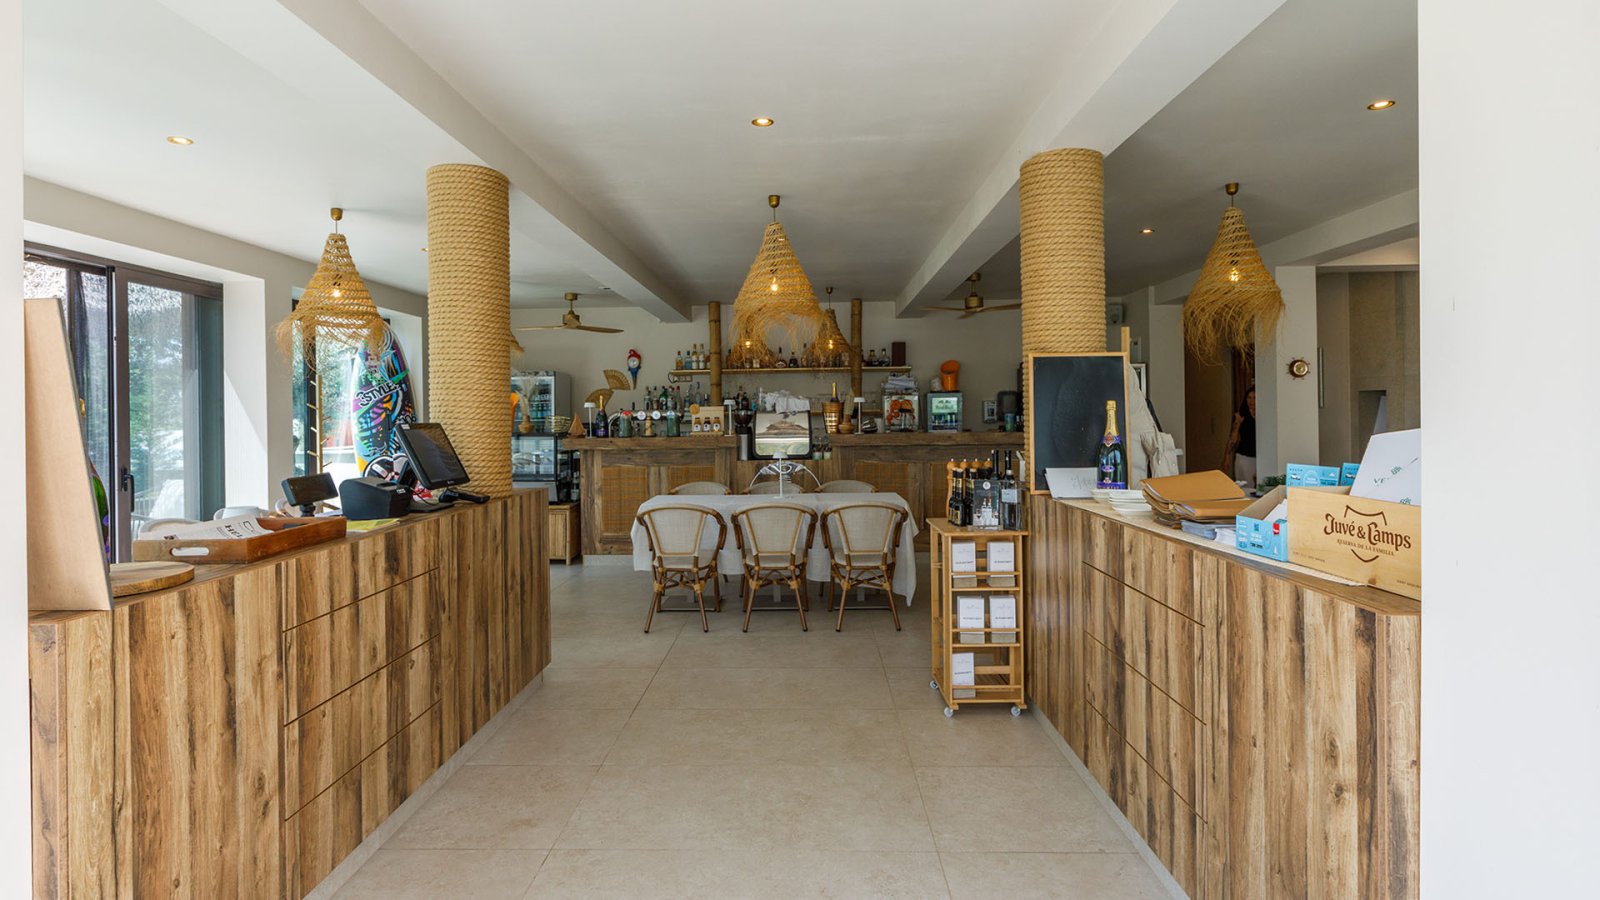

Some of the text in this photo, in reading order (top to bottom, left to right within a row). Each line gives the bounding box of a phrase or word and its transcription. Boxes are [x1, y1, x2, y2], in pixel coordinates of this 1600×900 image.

[1324, 513, 1412, 551] Juvé & Camps
[1337, 539, 1357, 548] RESERVA
[1372, 546, 1394, 556] FAMILIA
